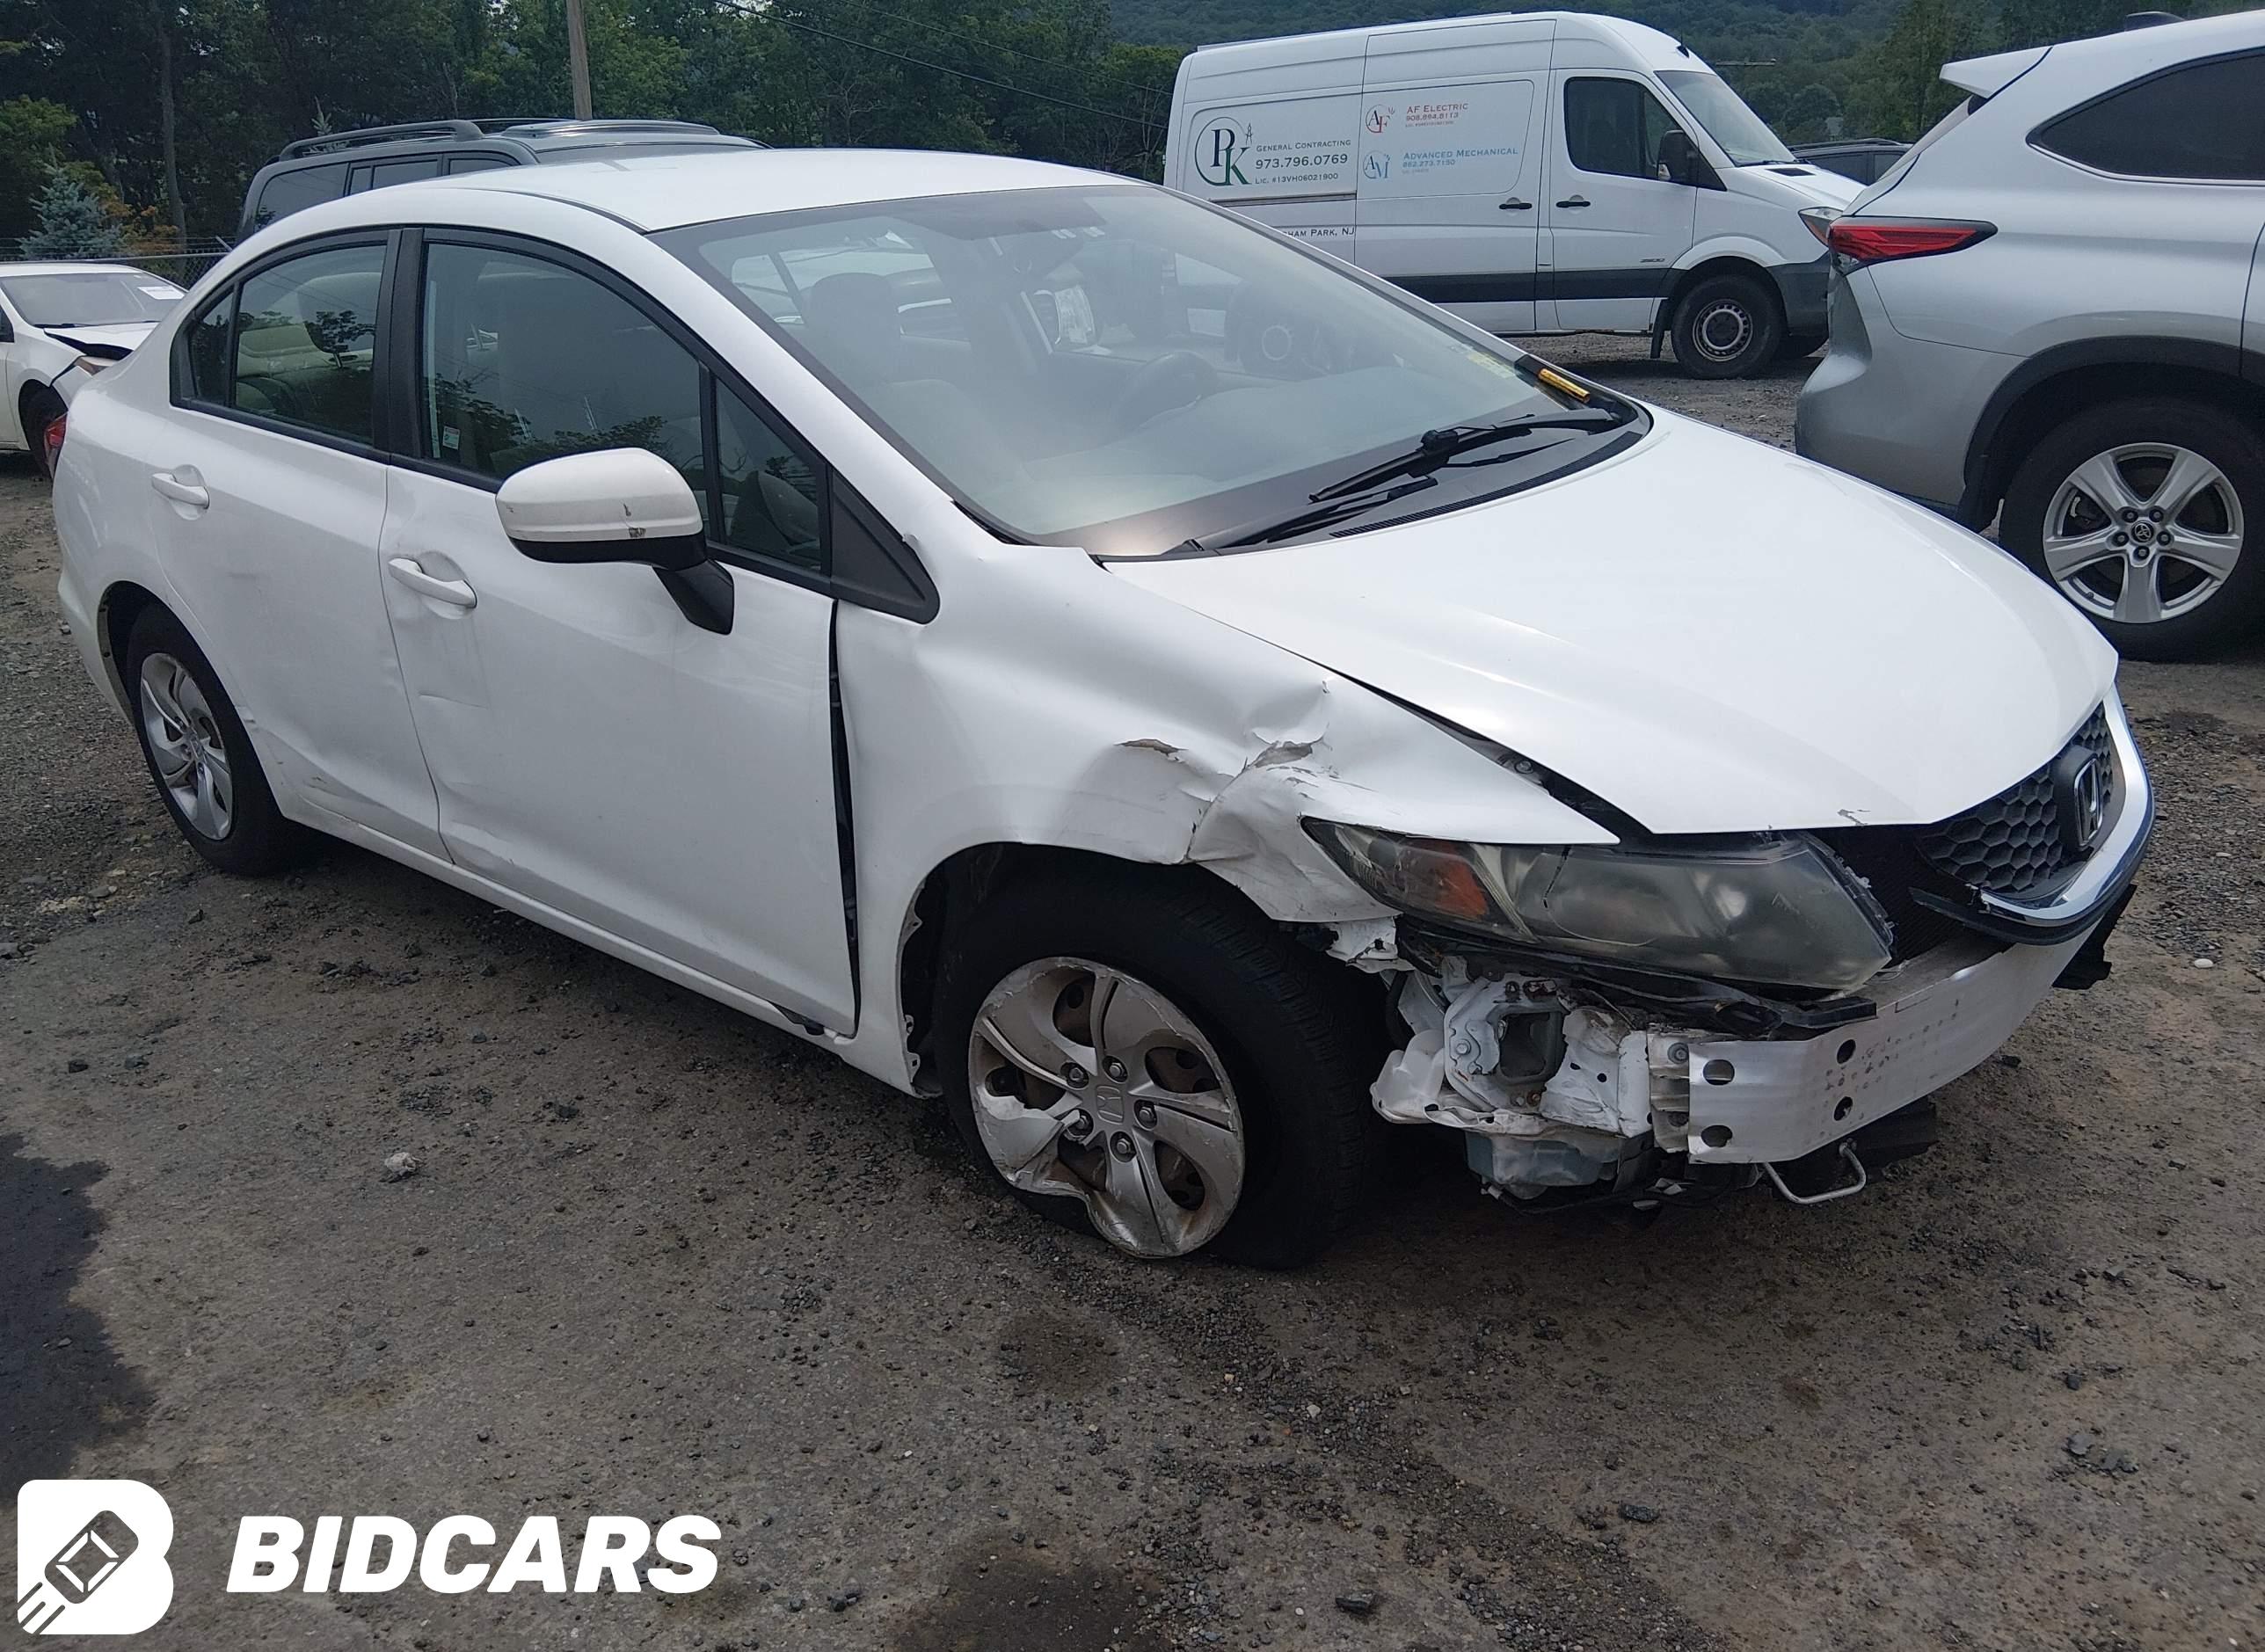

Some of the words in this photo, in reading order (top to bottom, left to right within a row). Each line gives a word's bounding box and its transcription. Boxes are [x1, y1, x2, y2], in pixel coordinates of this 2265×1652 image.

[1406, 106, 1421, 114] AF
[1423, 103, 1468, 113] ELECTRIC
[1256, 144, 1293, 153] GENERAL
[1295, 140, 1351, 149] CONTRACTING
[1402, 151, 1453, 161] ADVANCED
[1456, 148, 1518, 157] MECHANICAL
[1256, 154, 1348, 170] 973.796.0769
[1310, 229, 1337, 237] PARK,
[1342, 227, 1356, 236] NJ
